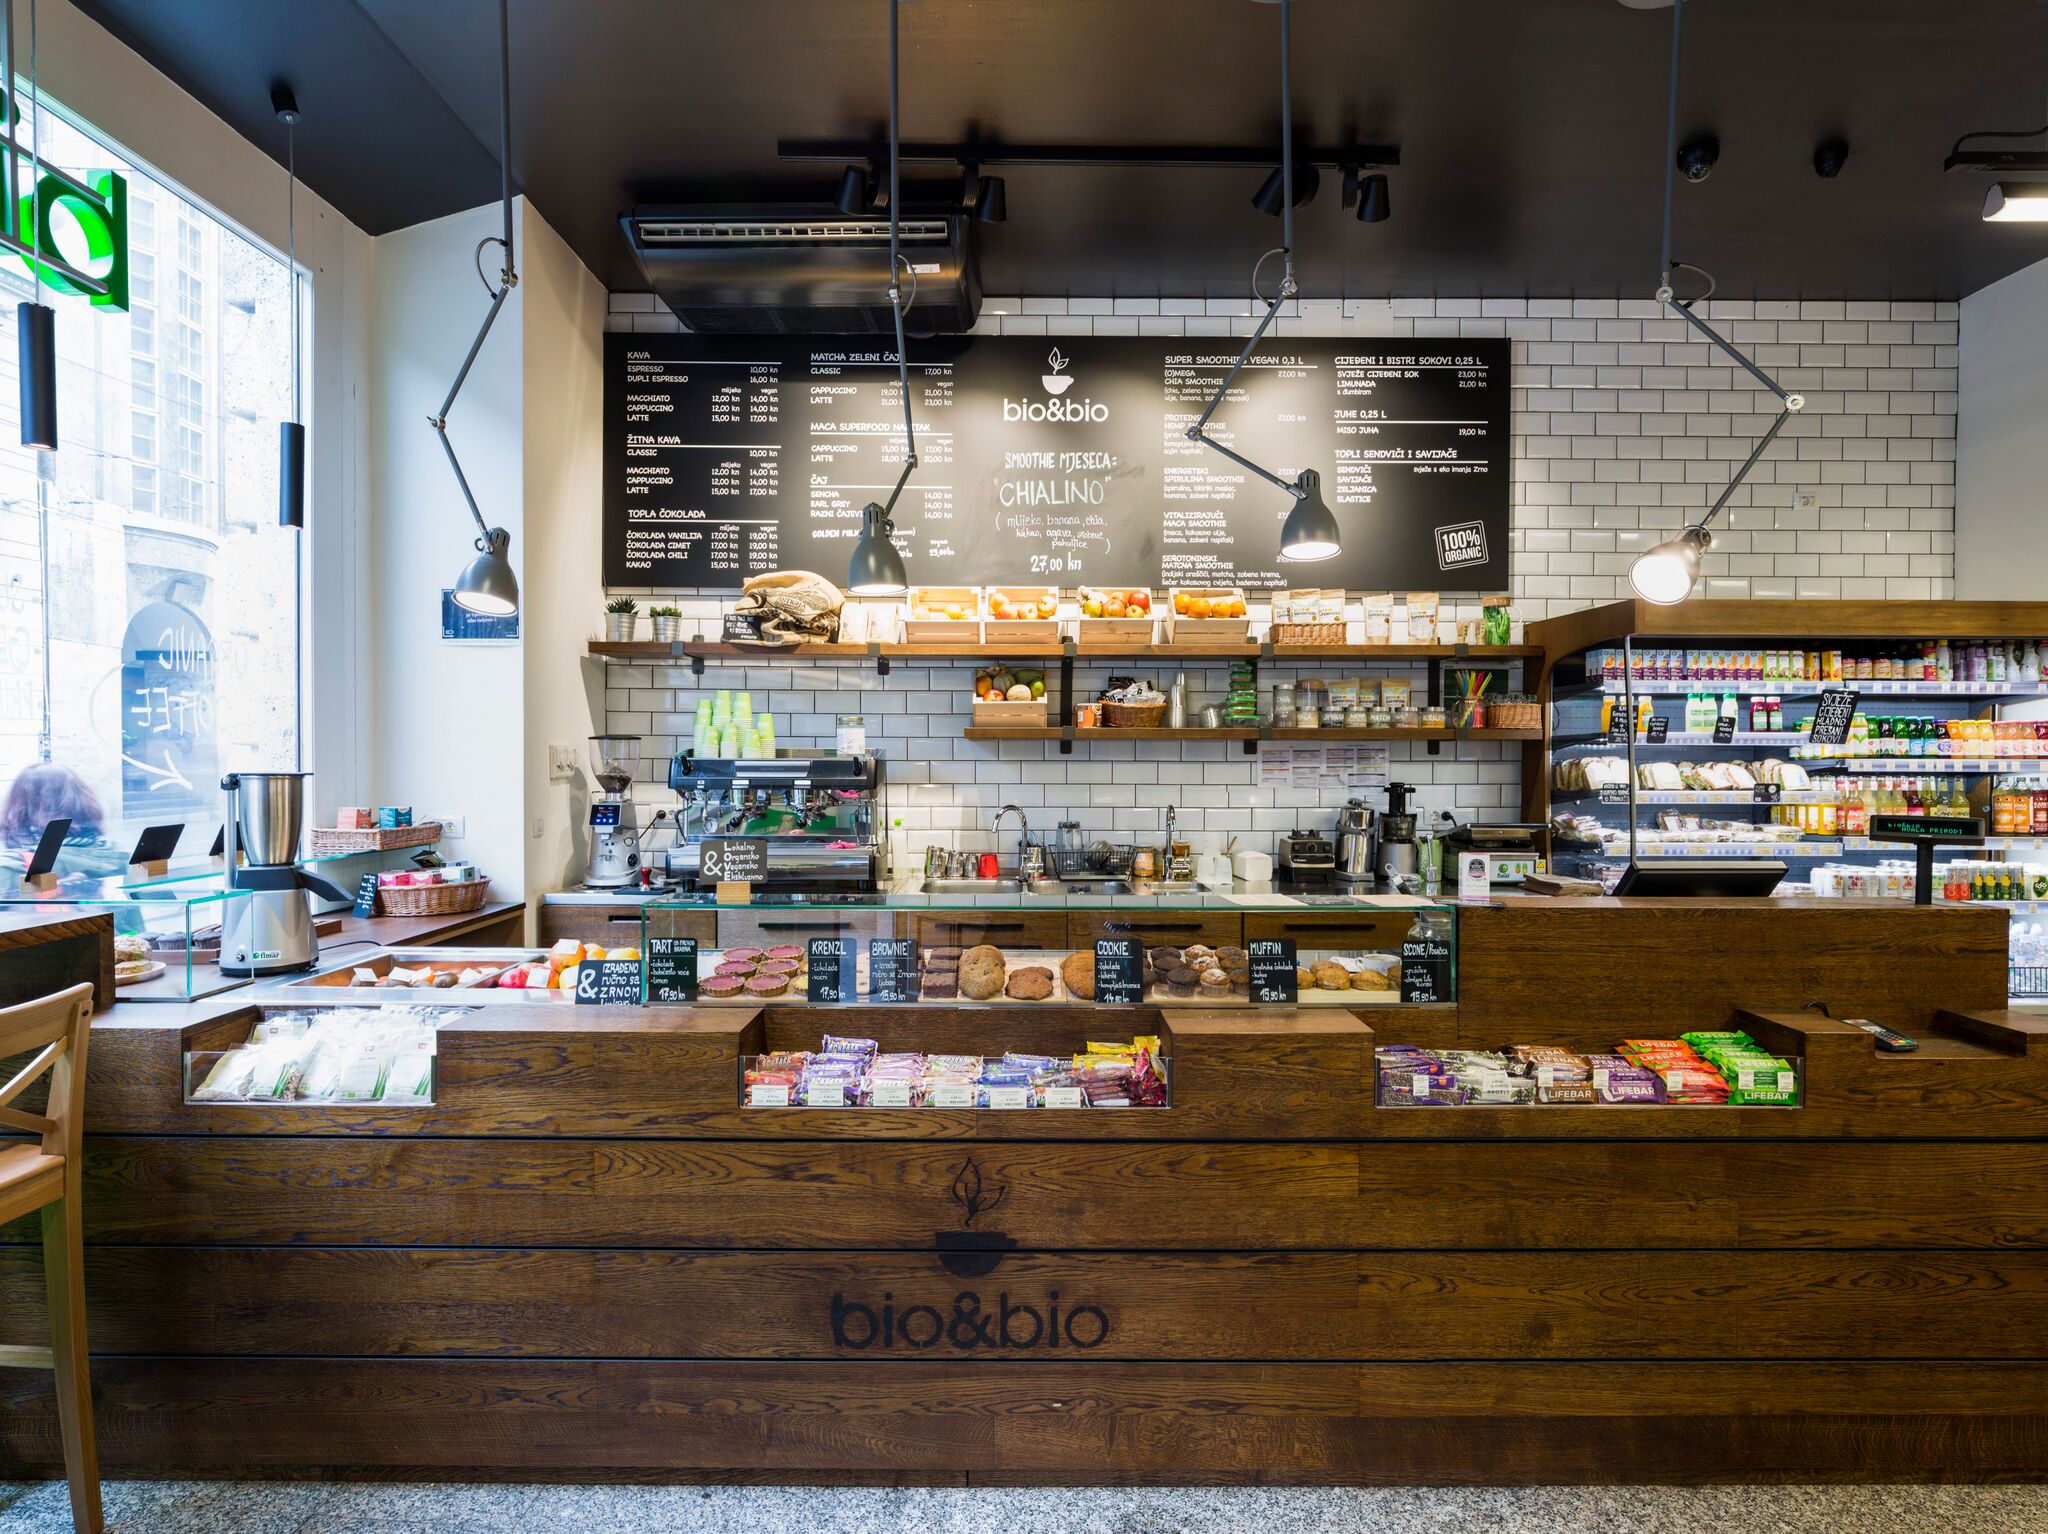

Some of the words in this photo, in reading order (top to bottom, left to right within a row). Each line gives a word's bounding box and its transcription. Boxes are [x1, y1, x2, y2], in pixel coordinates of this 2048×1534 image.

[1282, 357, 1294, 365] 0,3
[1455, 357, 1474, 366] 0,25
[1003, 398, 1108, 422] bio&bio
[1360, 410, 1378, 419] 0,25
[627, 434, 654, 444] ŽITNA
[1364, 448, 1404, 458] SENDVIČI
[1416, 448, 1457, 458] SAVIJAČE
[1005, 452, 1055, 469] SMOOTHIE
[811, 474, 828, 484] ČAJ
[628, 510, 656, 518] TOPLA
[659, 508, 706, 518] ČOKOLADA
[1442, 529, 1480, 550] 100%
[1445, 547, 1482, 563] ORGANIC
[1822, 692, 1854, 707] SVJEŽE
[1816, 717, 1846, 726] HLADNO
[1812, 734, 1840, 743] SOKOVI
[724, 842, 755, 851] Lokalno
[724, 852, 759, 863] Organsko
[724, 861, 758, 872] Vegansko
[651, 939, 672, 954] TART
[812, 941, 846, 955] KRENZL
[1098, 941, 1128, 956] COOKIE
[1250, 942, 1282, 955] MUFFIN
[602, 963, 638, 973] IZRAĐENO
[630, 976, 640, 985] sa
[599, 986, 639, 998] ZRNOM
[1548, 1089, 1592, 1099] LIFEBAR
[1611, 1086, 1655, 1097] LIFEBAR
[1744, 1091, 1789, 1100] LIFEBAR
[830, 1290, 1111, 1350] bio&bio
